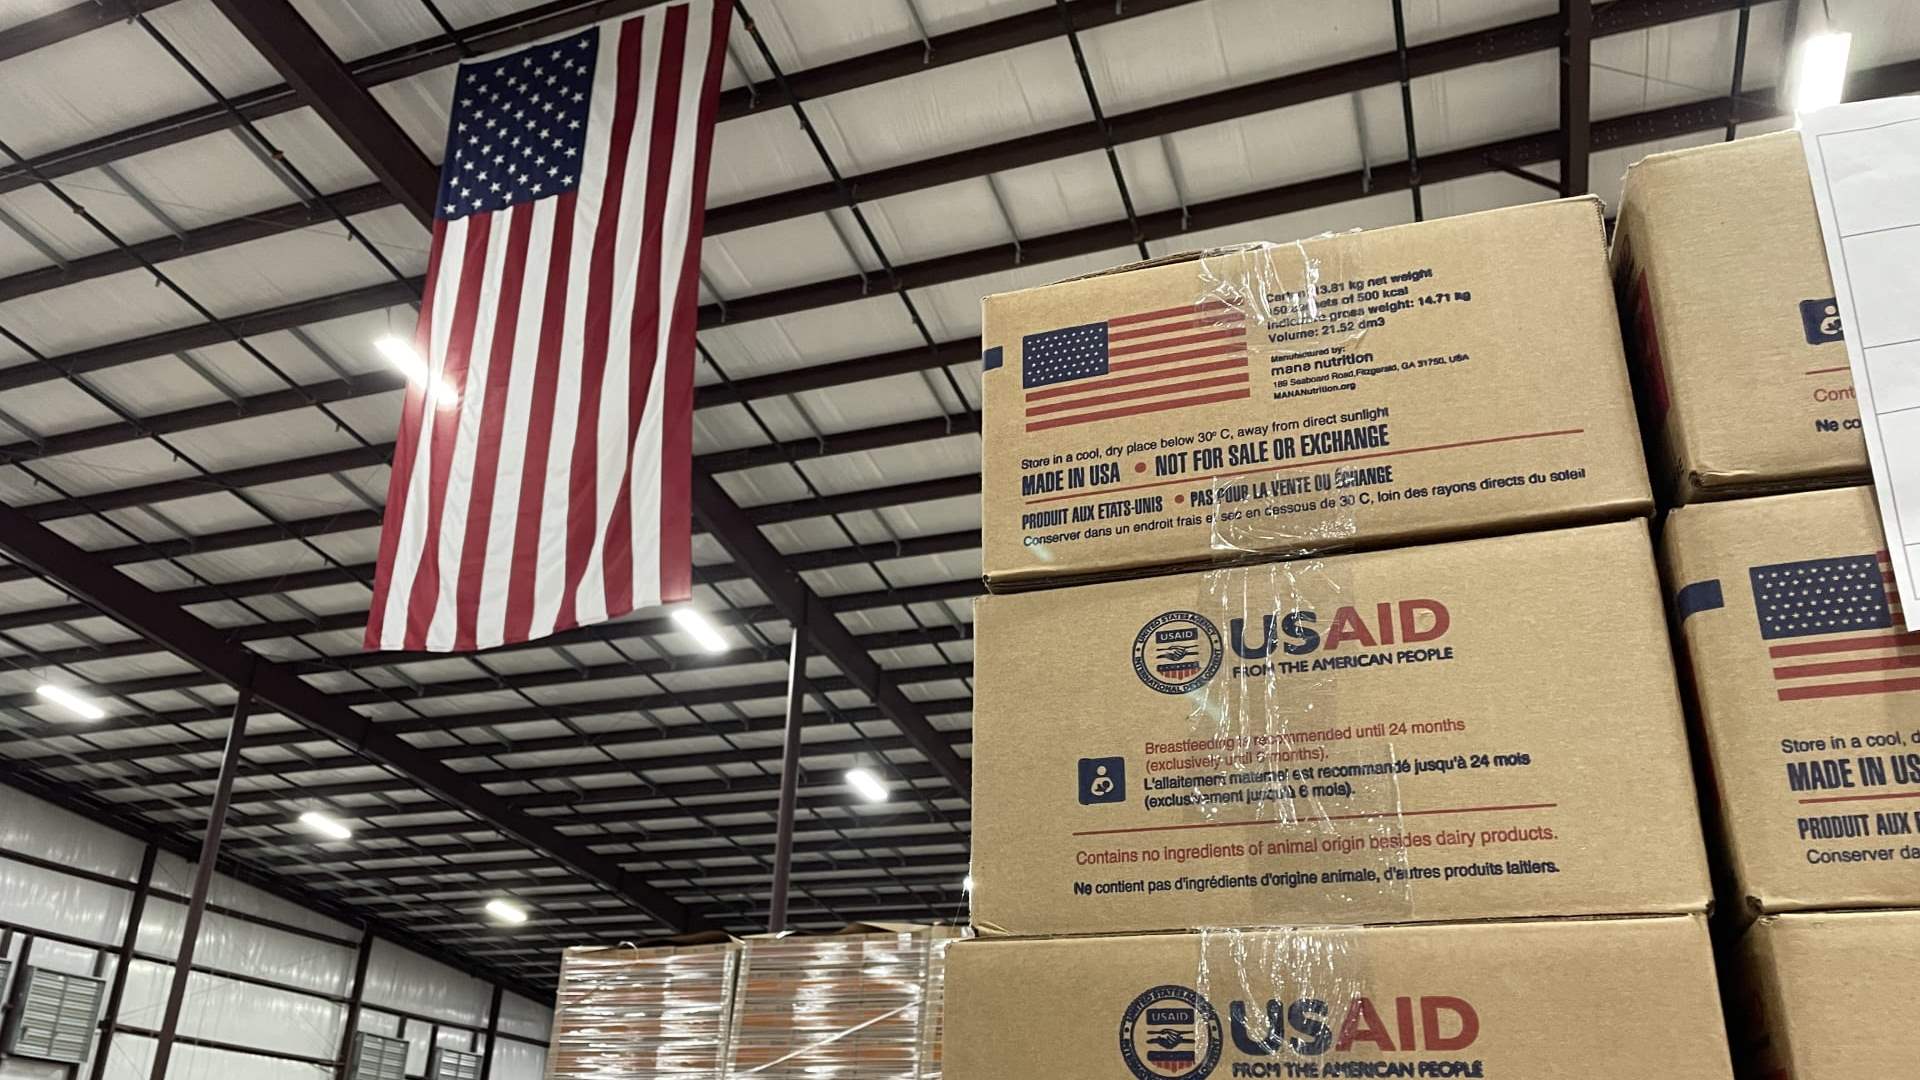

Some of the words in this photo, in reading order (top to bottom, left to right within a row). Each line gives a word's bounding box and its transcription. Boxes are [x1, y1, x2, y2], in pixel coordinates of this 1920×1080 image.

[1315, 282, 1345, 297] 13.81
[1349, 279, 1365, 290] kg
[1367, 276, 1387, 287] net
[1390, 268, 1433, 284] weight
[1267, 315, 1326, 330] Indice
[1329, 308, 1365, 323] gross
[1368, 298, 1414, 315] weight:
[1418, 293, 1450, 306] 14.71
[1290, 298, 1338, 313] sacets
[1343, 292, 1354, 305] of
[1357, 289, 1379, 301] 500
[1383, 286, 1408, 299] kcal
[1269, 328, 1319, 344] Volume:
[1322, 322, 1354, 336] 21.52
[1359, 317, 1385, 330] dm3
[1271, 347, 1329, 363] Manufactured
[1331, 346, 1345, 356] by:
[1271, 362, 1311, 376] mana
[1314, 351, 1373, 370] nutrition
[1290, 374, 1329, 387] Seaboard
[1401, 361, 1415, 370] GA
[1450, 353, 1470, 364] USA
[1273, 382, 1356, 400] MANANutrition.org
[1021, 459, 1050, 470] Store
[1053, 454, 1063, 465] in
[1066, 453, 1073, 463] a
[1076, 450, 1102, 461] cool,
[1105, 445, 1124, 458] dry
[1126, 441, 1157, 455] place
[1160, 434, 1194, 448] below
[1220, 428, 1234, 440] C,
[1237, 424, 1269, 437] away
[1272, 420, 1299, 432] from
[1303, 413, 1337, 428] direct
[1340, 406, 1389, 423] sunlight
[1815, 418, 1839, 432] Ne
[1022, 470, 1064, 496] MADE
[1068, 467, 1085, 489] IN
[1089, 461, 1121, 487] USA
[1155, 452, 1189, 477] NOT
[1193, 446, 1224, 472] FOR
[1228, 440, 1268, 466] SALE
[1273, 437, 1296, 461] OR
[1300, 423, 1390, 457] EXCHANGE
[1022, 508, 1069, 530] PRODUIT
[1072, 504, 1095, 523] AUX
[1098, 496, 1163, 520] ETATS-UNIS
[1190, 490, 1213, 508] PAS
[1217, 484, 1249, 504] POUR
[1253, 481, 1268, 498] LA
[1271, 476, 1311, 497] VENTE
[1315, 473, 1331, 492] OU
[1023, 530, 1080, 546] Conserver
[1084, 525, 1112, 539] dans
[1115, 522, 1130, 535] un
[1133, 516, 1173, 533] endroit
[1177, 513, 1202, 527] frais
[1221, 511, 1242, 522] sec
[1245, 508, 1261, 518] en
[1265, 501, 1316, 516] dessous
[1320, 497, 1336, 509] de
[1359, 491, 1374, 505] C,
[1377, 488, 1401, 502] loin
[1404, 486, 1428, 500] des
[1432, 480, 1477, 498] rayons
[1480, 474, 1525, 491] directs
[1528, 471, 1546, 485] du
[1550, 468, 1586, 482] soleil
[1160, 631, 1193, 641] USAID
[1230, 598, 1451, 660] USAID
[1182, 648, 1221, 692] DEVOPMENT
[1233, 662, 1278, 679] FROM
[1280, 658, 1308, 674] THE
[1312, 652, 1393, 672] AMERICAN
[1396, 647, 1454, 663] PEOPLE
[1145, 737, 1235, 754] Breastfeeding
[1254, 727, 1352, 746] recommended
[1356, 724, 1385, 738] until
[1389, 723, 1407, 736] 24
[1411, 719, 1466, 734] months
[1781, 738, 1826, 753] Store
[1830, 736, 1846, 749] in
[1851, 737, 1862, 748] a
[1866, 731, 1907, 747] cool,
[1144, 773, 1226, 791] L'allaitement
[1230, 768, 1288, 784] materne
[1292, 767, 1314, 780] est
[1318, 759, 1411, 778] recommandé
[1414, 755, 1467, 775] jusqu'à
[1470, 754, 1490, 768] 24
[1493, 752, 1531, 767] mois
[1146, 755, 1220, 774] (exclusively
[1225, 751, 1252, 766] until
[1269, 746, 1329, 763] months).
[1787, 758, 1855, 791] MADE
[1857, 756, 1887, 787] IN
[1145, 791, 1243, 810] (exclusivement
[1299, 785, 1308, 797] 6
[1312, 781, 1356, 799] mois).
[1797, 814, 1870, 840] PRODUIT
[1876, 812, 1912, 836] AUX
[1077, 849, 1138, 865] Contains
[1142, 848, 1160, 862] no
[1164, 842, 1245, 864] ingredients
[1249, 840, 1263, 855] of
[1267, 838, 1318, 856] animal
[1322, 835, 1365, 854] origin
[1370, 830, 1432, 849] besides
[1436, 829, 1475, 848] dairy
[1481, 825, 1559, 846] products.
[1806, 848, 1895, 864] Conserver
[1074, 881, 1092, 896] Ne
[1095, 879, 1144, 894] contient
[1149, 879, 1171, 898] pas
[1175, 873, 1257, 893] d'ingrédients
[1261, 870, 1318, 888] d'origine
[1321, 868, 1380, 883] animale,
[1383, 863, 1441, 881] d'autres
[1444, 861, 1503, 880] produits
[1506, 859, 1560, 874] laitiers.
[1151, 1012, 1189, 1021] USAID
[1229, 995, 1480, 1056] USAID
[1232, 1061, 1281, 1078] FROM
[1284, 1060, 1319, 1079] THE
[1322, 1059, 1415, 1079] AMERICAN
[1418, 1059, 1484, 1079] PEOPLE
